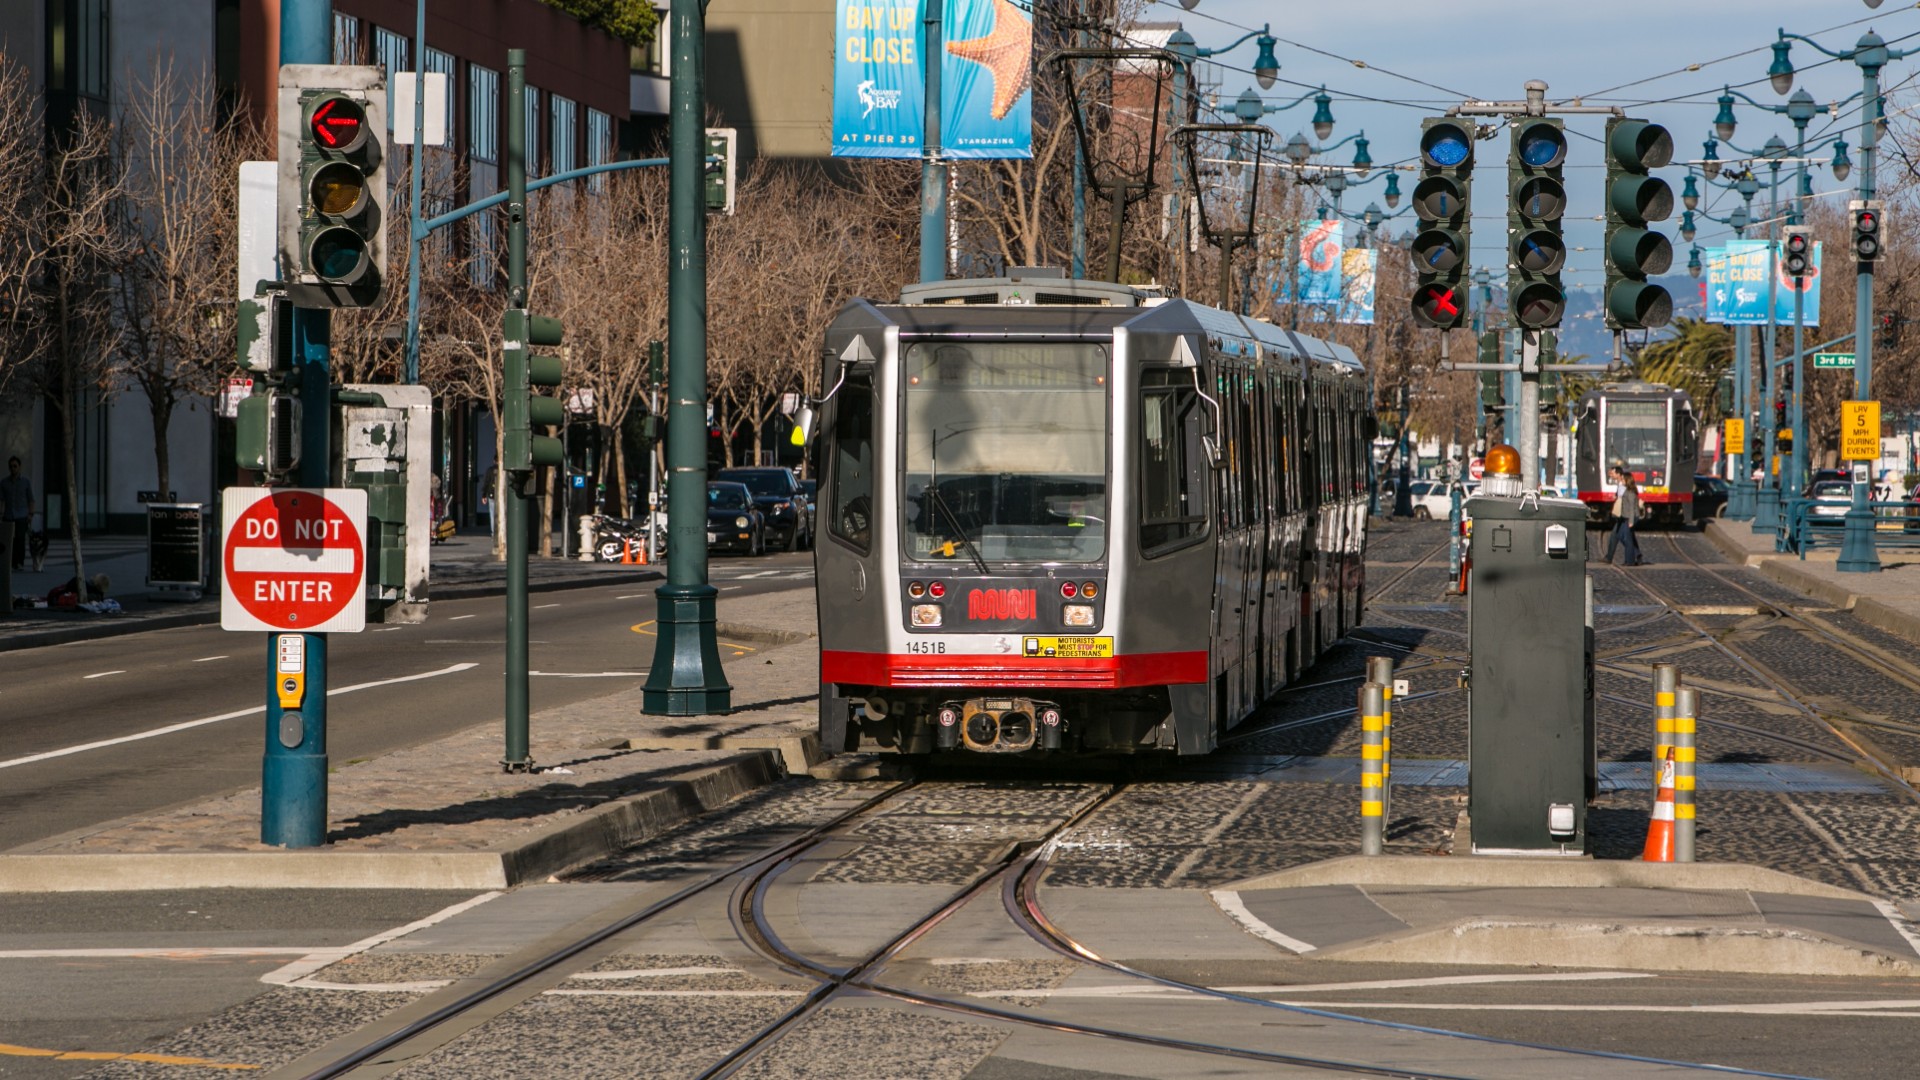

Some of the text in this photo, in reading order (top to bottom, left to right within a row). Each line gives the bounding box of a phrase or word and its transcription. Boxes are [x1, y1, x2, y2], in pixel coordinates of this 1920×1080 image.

[846, 5, 915, 31] BAY UP
[846, 36, 914, 64] CLOSE
[876, 96, 900, 109] BAY
[841, 133, 915, 144] AT PIER 39
[958, 137, 1014, 145] STARGAZING
[1730, 253, 1764, 266] BAY UP
[1730, 268, 1763, 281] CLOSE
[1819, 356, 1835, 365] 3rd
[1853, 405, 1868, 413] LRV
[1857, 414, 1865, 427] 5
[1847, 438, 1876, 446] DURING
[1846, 447, 1876, 455] EVENTS
[245, 518, 343, 540] DO NOT
[254, 580, 333, 602] ENTER
[968, 588, 1037, 621] MUNI
[906, 641, 946, 654] 1451B
